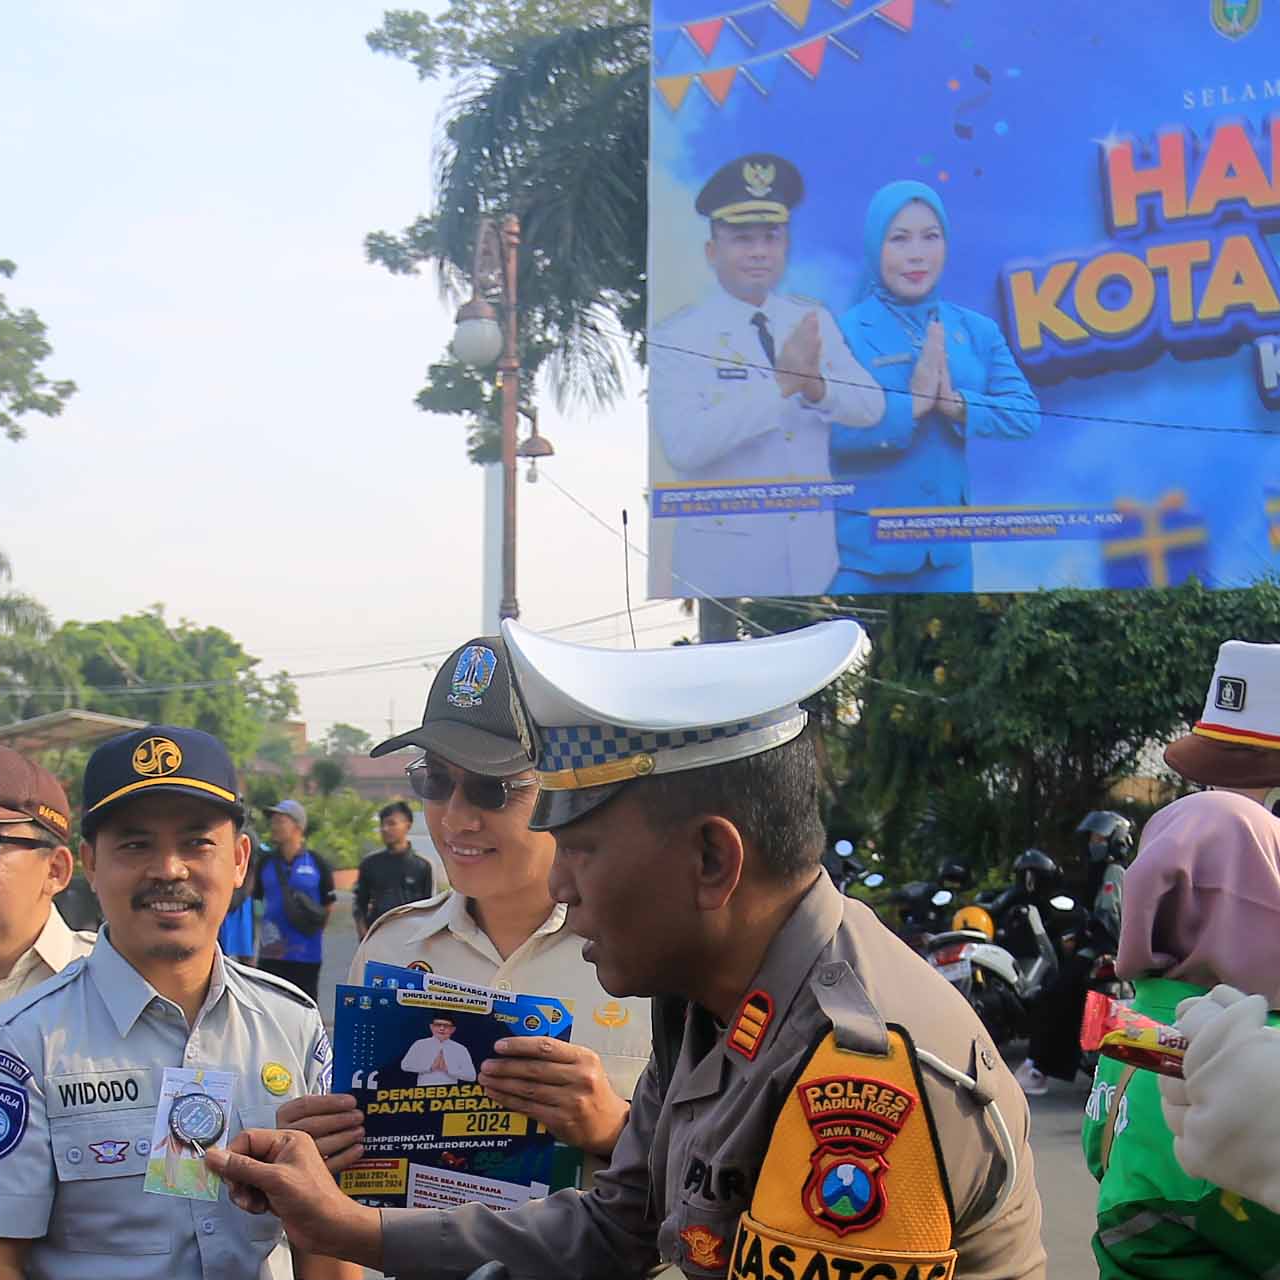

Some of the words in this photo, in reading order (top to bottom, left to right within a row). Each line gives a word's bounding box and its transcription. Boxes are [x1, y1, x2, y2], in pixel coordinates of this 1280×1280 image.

[402, 992, 433, 1001] KHUSUS
[434, 995, 464, 1004] WARGA
[464, 999, 488, 1007] JATIM
[428, 979, 459, 991] KHUSUS
[458, 985, 489, 998] WARGA
[488, 993, 511, 1003] JATIM
[58, 1078, 139, 1108] WIDODO
[805, 1080, 910, 1113] POLRES
[367, 1100, 425, 1115] PAJAK
[810, 1097, 866, 1113] MADIUN
[866, 1100, 901, 1122] KOTA
[466, 1113, 511, 1133] 2024
[416, 1140, 496, 1150] KEMERDEKAAN
[820, 1126, 852, 1138] JAWA
[854, 1127, 886, 1145] TIMUR
[479, 1184, 503, 1195] NAMA
